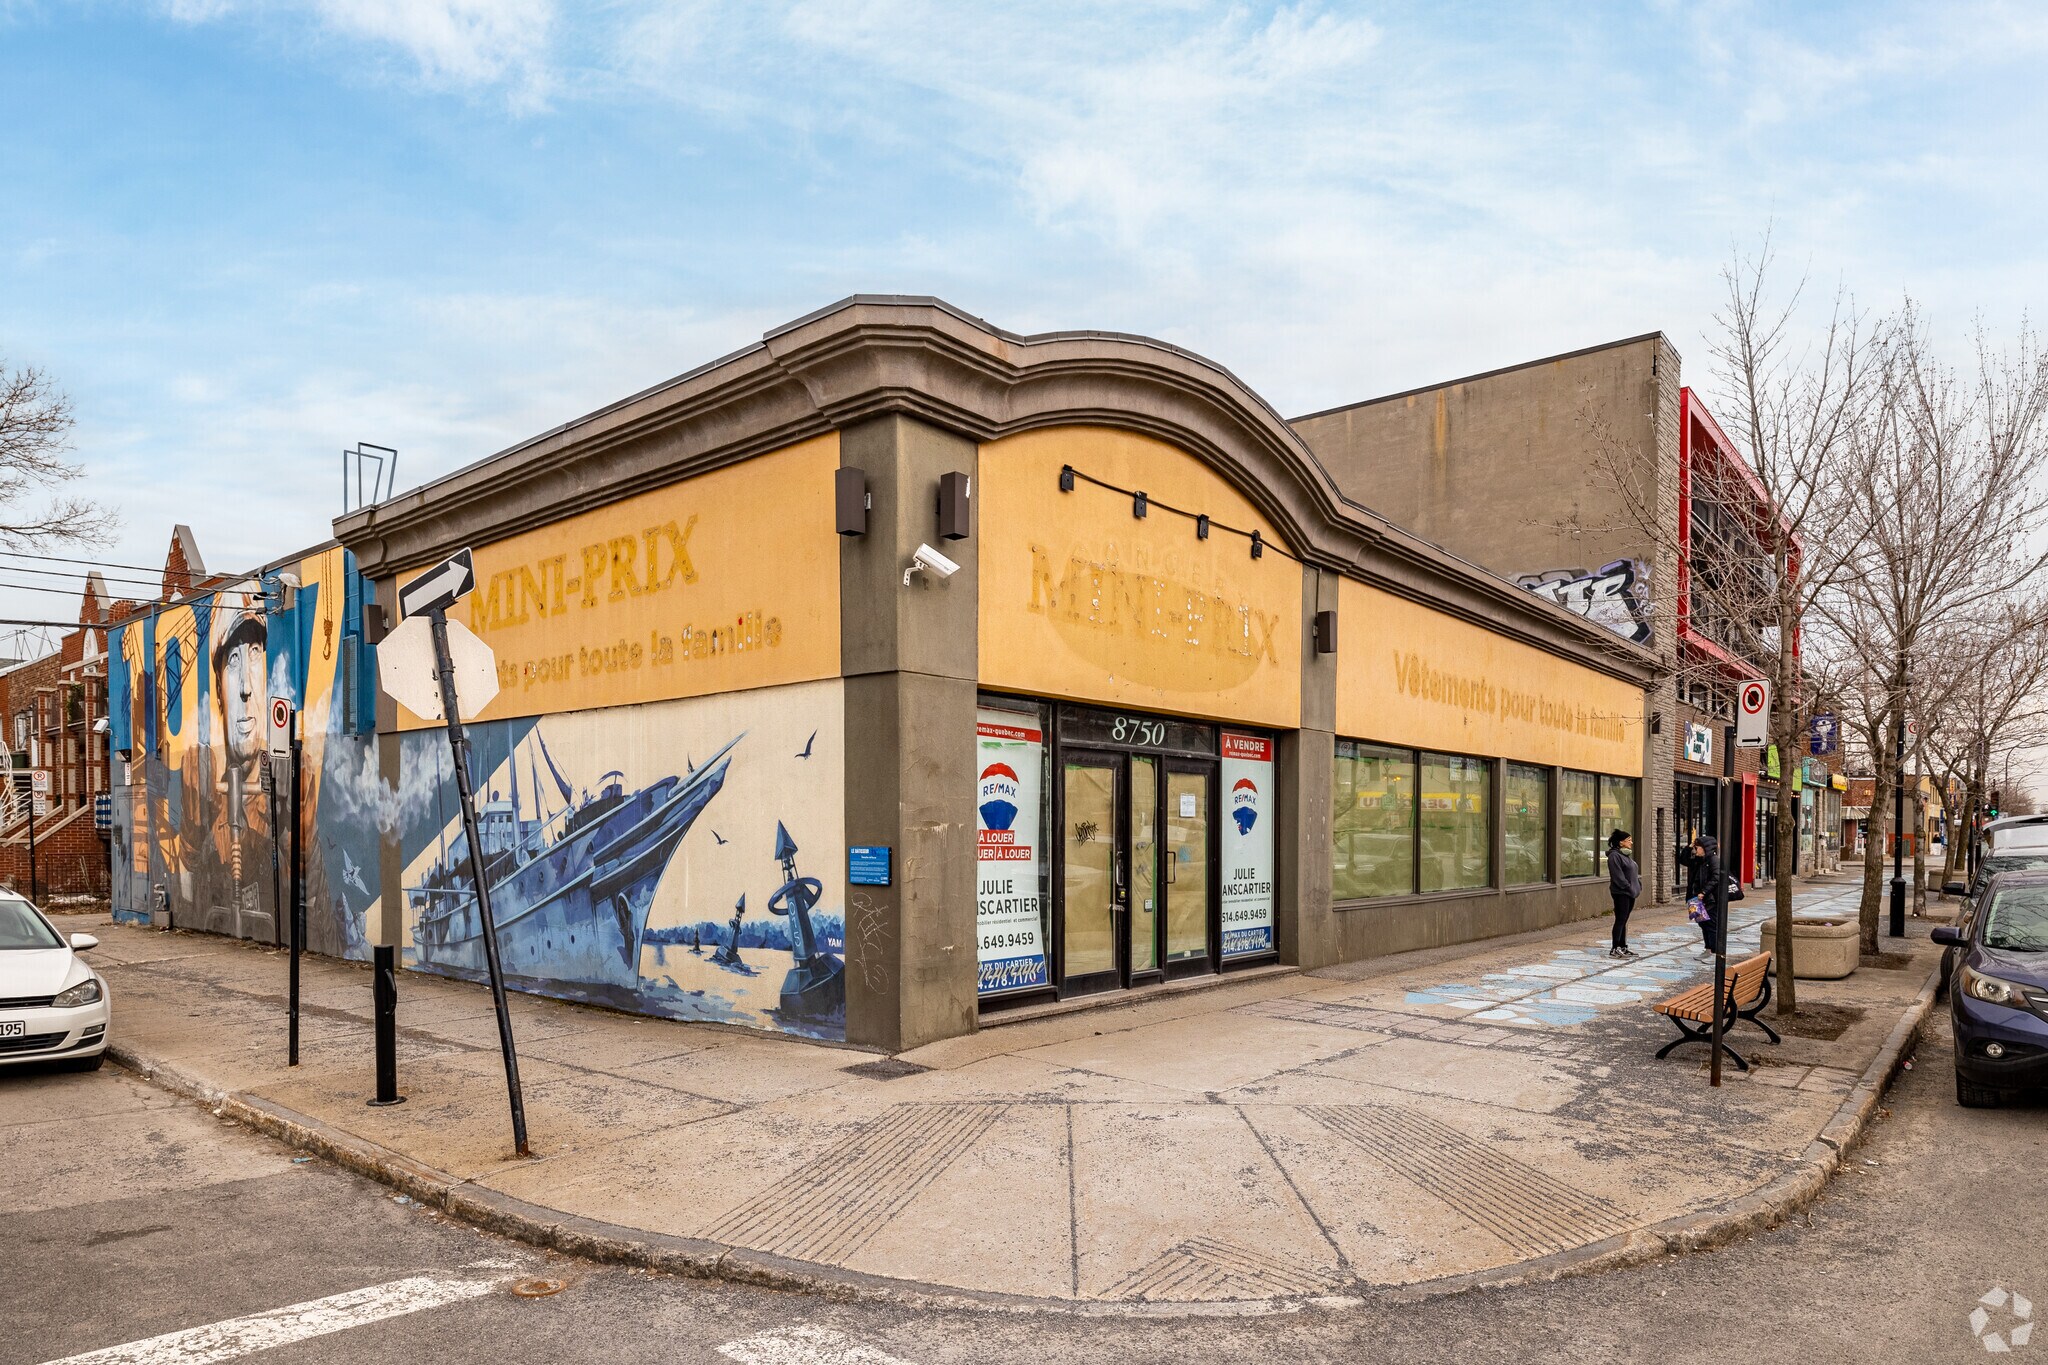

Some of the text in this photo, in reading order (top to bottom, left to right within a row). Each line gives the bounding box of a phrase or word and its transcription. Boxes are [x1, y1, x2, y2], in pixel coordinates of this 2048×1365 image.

[470, 514, 699, 634] MINI-PRIX
[524, 651, 574, 692] pour
[579, 641, 644, 677] toute
[651, 629, 674, 666] la
[681, 608, 783, 662] famille
[1500, 685, 1536, 724] pour
[1539, 693, 1574, 732] toute
[1112, 716, 1165, 746] 8750
[1225, 736, 1265, 752] À VENDRE
[983, 783, 1017, 798] RE/MAX
[1234, 794, 1257, 806] RE/MAX
[978, 830, 1014, 843] À LOUER
[997, 847, 1003, 859] À
[1005, 848, 1031, 859] LOUER
[1233, 867, 1256, 880] JULIE
[979, 879, 1013, 896] JULIE
[976, 897, 1039, 915] SCARTIER
[1222, 908, 1267, 923] 514.649.9459
[827, 936, 842, 948] YAM
